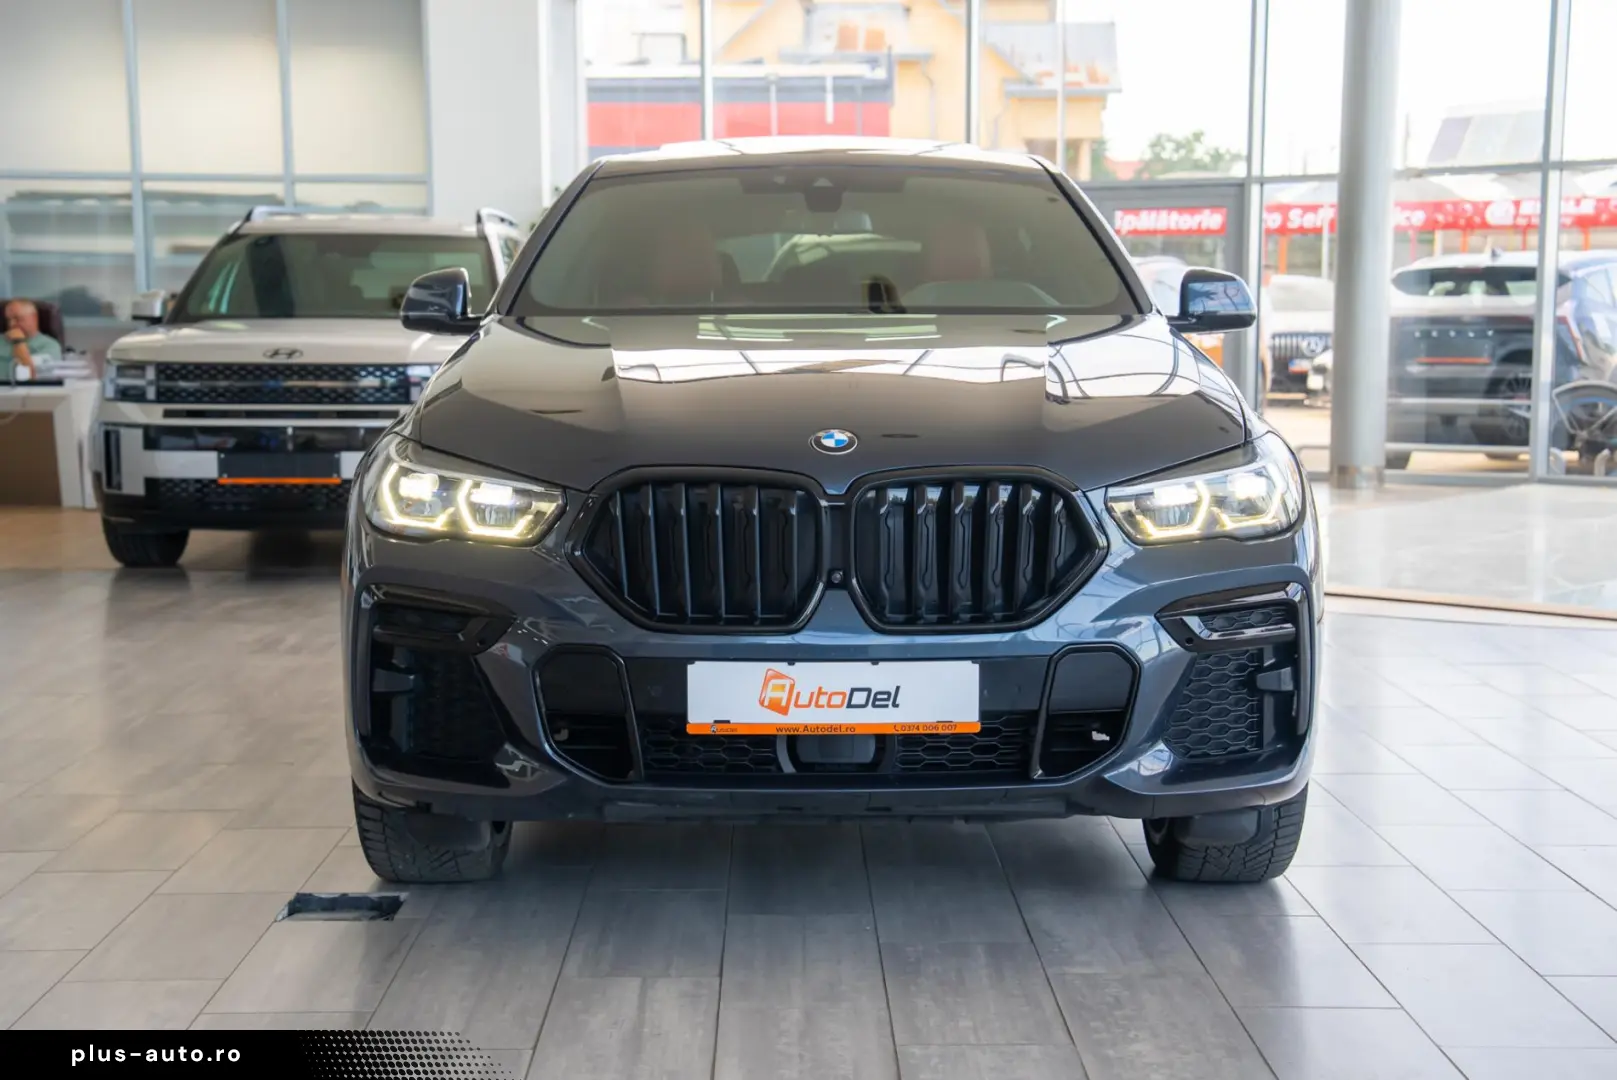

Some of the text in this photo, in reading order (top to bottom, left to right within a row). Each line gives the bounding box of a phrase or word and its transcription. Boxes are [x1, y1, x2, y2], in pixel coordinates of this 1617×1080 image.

[760, 675, 900, 711] AutoDel
[775, 724, 856, 733] www.Autodel.ro
[901, 724, 920, 732] 0374
[941, 723, 957, 731] 007
